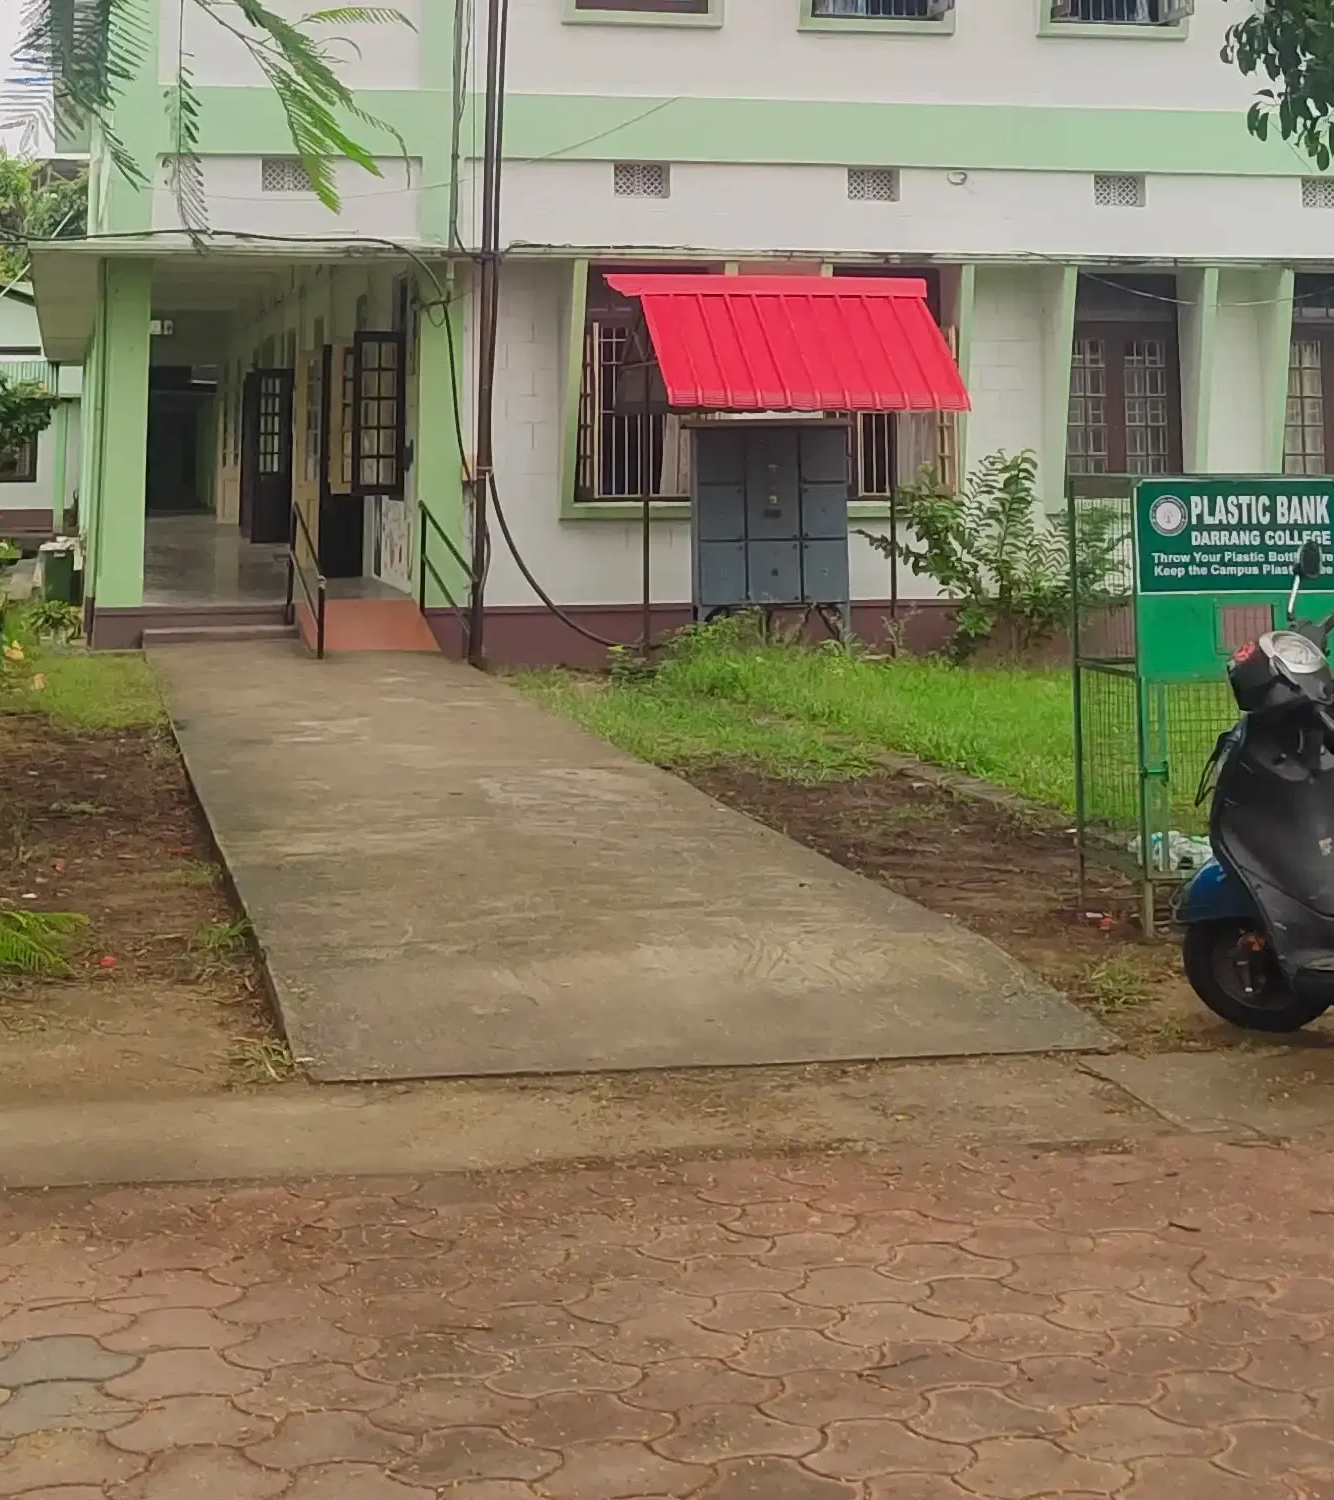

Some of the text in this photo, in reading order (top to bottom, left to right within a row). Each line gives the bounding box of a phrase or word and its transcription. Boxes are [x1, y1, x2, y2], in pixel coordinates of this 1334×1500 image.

[1190, 496, 1270, 525] PLASTIC
[1276, 496, 1330, 525] BANK
[1191, 530, 1332, 546] DARRANG COLLEGE
[1151, 552, 1190, 563] Throw
[1193, 552, 1222, 562] Your
[1224, 551, 1266, 562] Plastic
[1154, 565, 1186, 577] Keep
[1188, 564, 1208, 575] the
[1210, 565, 1260, 577] Campus
[1262, 565, 1293, 575] Plast
